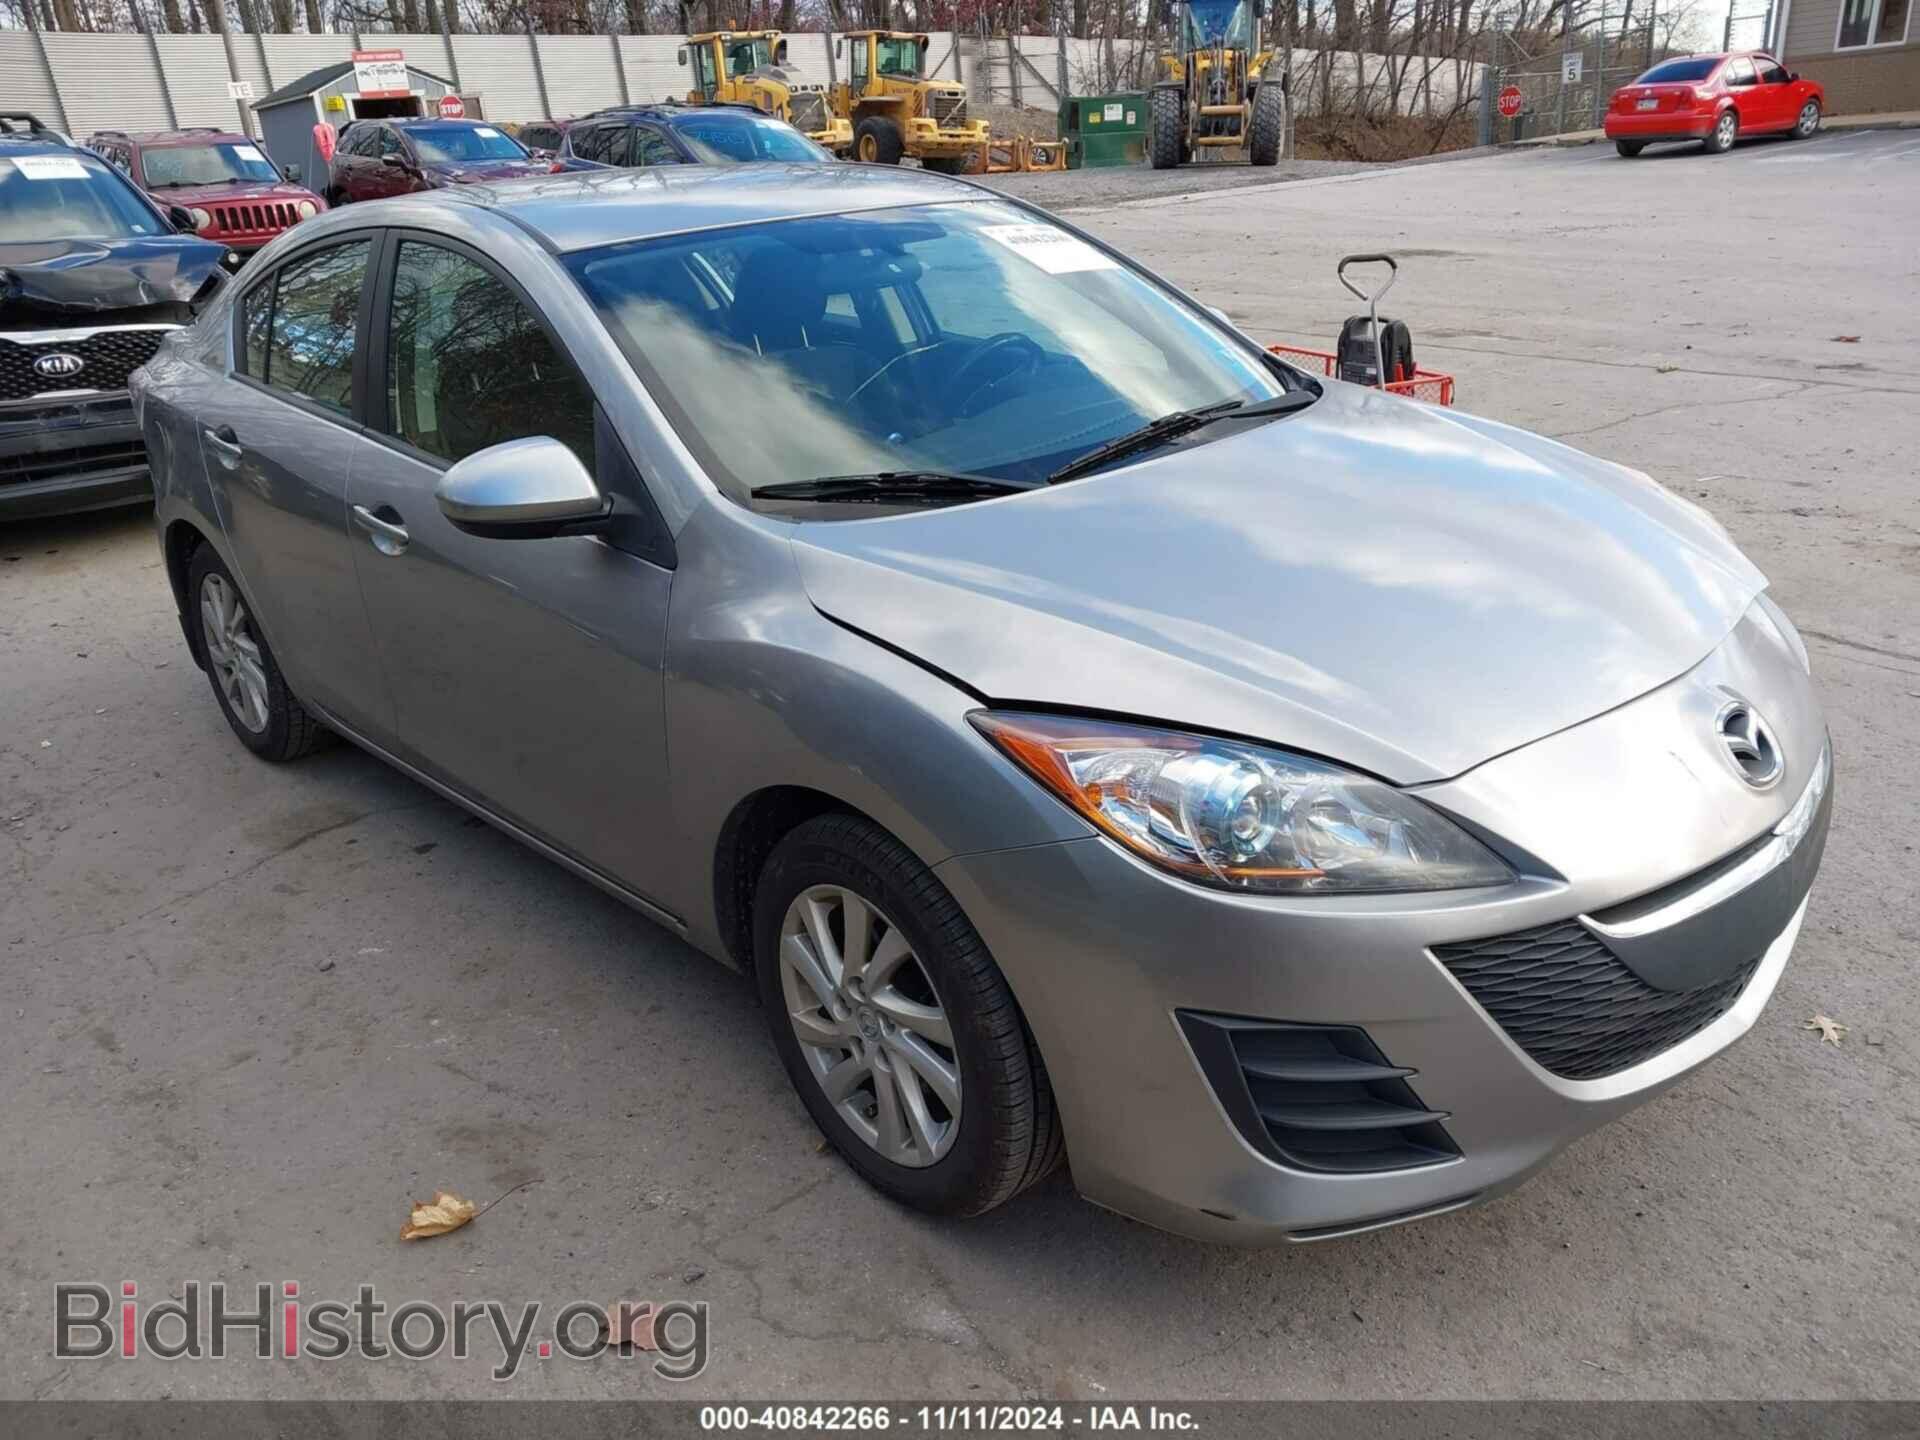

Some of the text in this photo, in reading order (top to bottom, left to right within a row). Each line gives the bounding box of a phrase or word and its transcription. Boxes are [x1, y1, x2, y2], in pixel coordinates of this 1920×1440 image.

[1568, 68, 1576, 80] 5
[1499, 95, 1520, 108] STOP
[440, 104, 462, 114] STOP
[41, 358, 76, 373] KIA
